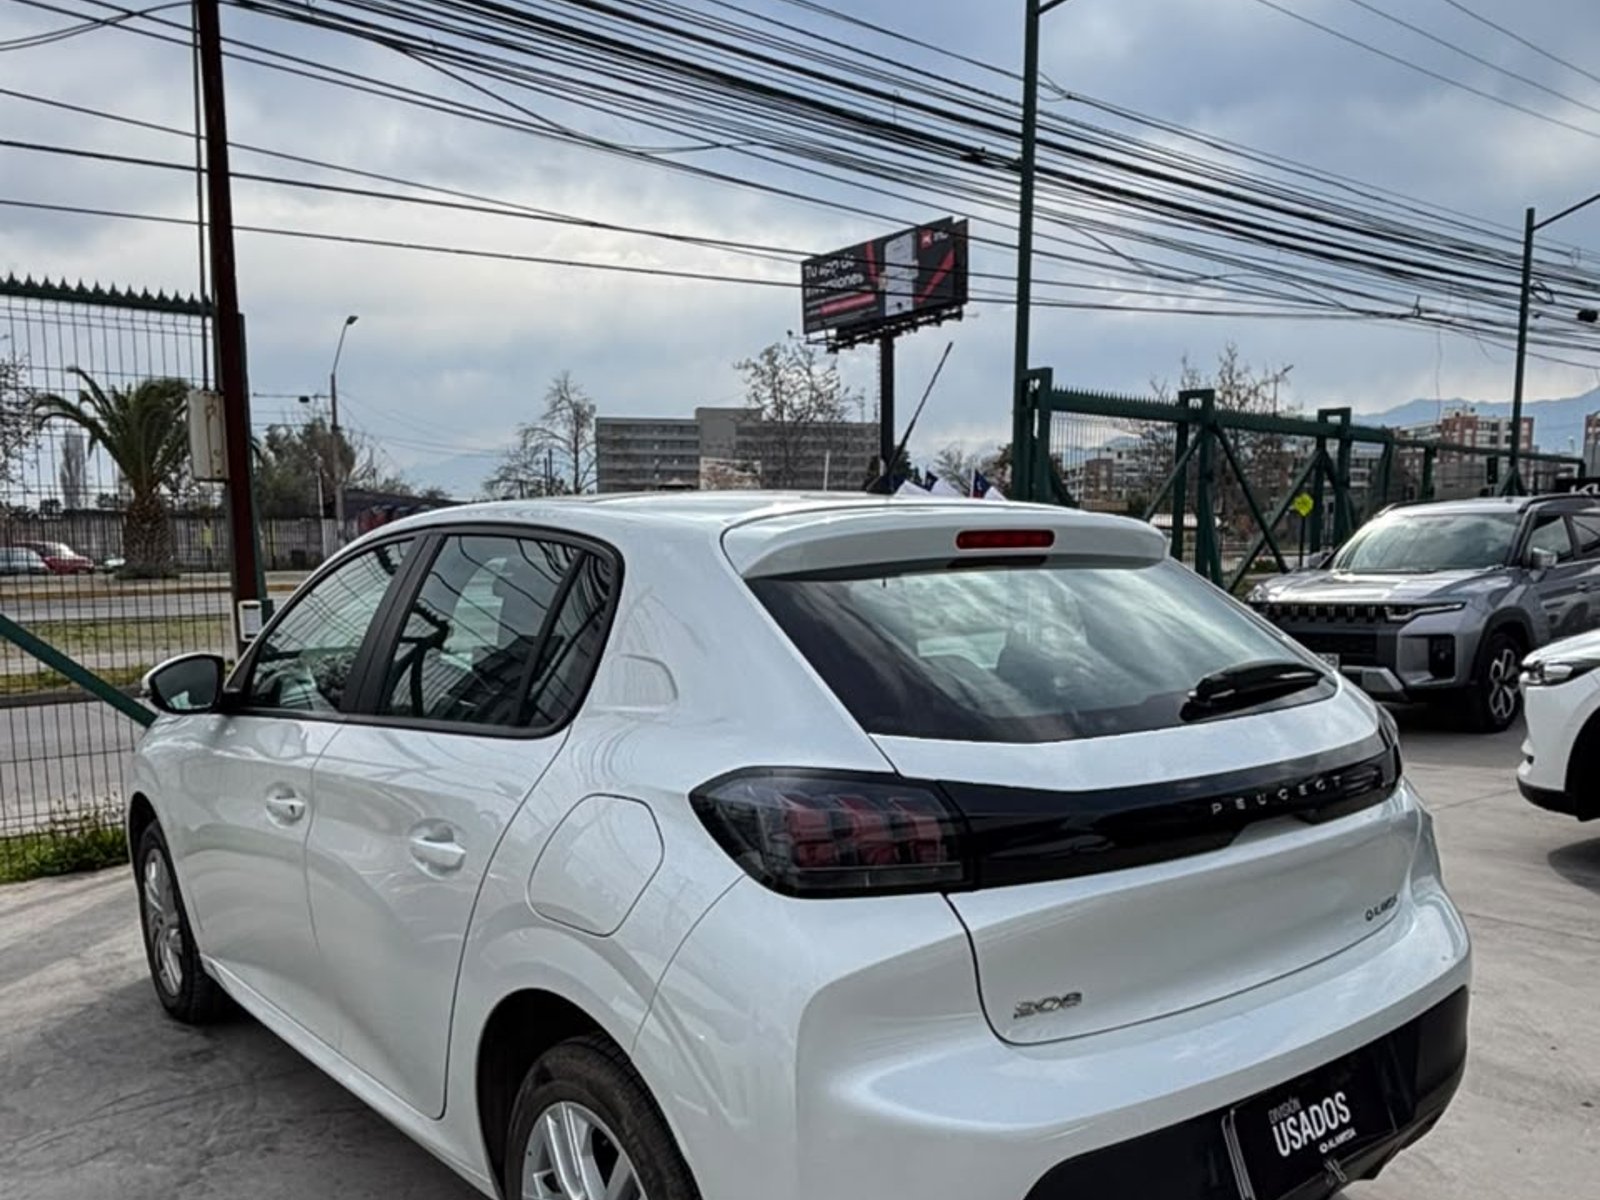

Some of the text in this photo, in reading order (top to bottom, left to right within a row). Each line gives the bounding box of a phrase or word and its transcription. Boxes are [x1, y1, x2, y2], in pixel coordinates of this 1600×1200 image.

[1570, 482, 1600, 495] KI
[1211, 775, 1342, 814] PEUGEOT
[1272, 1091, 1351, 1157] USADOS
